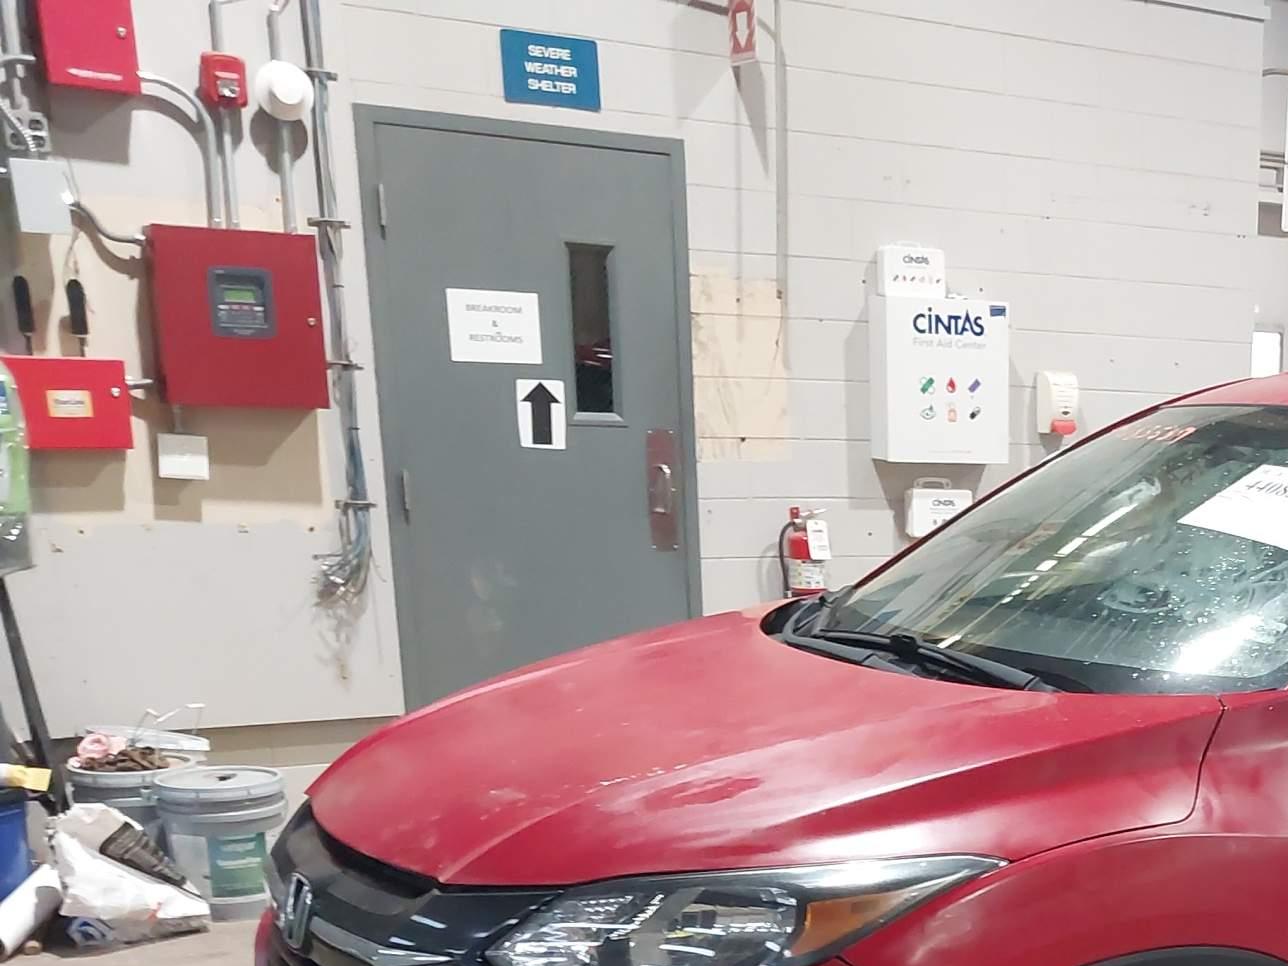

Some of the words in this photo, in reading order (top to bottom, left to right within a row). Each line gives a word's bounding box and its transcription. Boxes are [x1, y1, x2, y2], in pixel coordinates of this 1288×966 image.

[527, 44, 572, 61] SEVERE
[523, 61, 578, 78] WEATHER
[527, 78, 577, 95] SHELTER
[465, 304, 523, 314] BREAKROOM
[468, 333, 524, 344] RESTROOMS
[912, 337, 935, 348] First
[936, 339, 953, 349] Aid
[954, 339, 987, 350] Center
